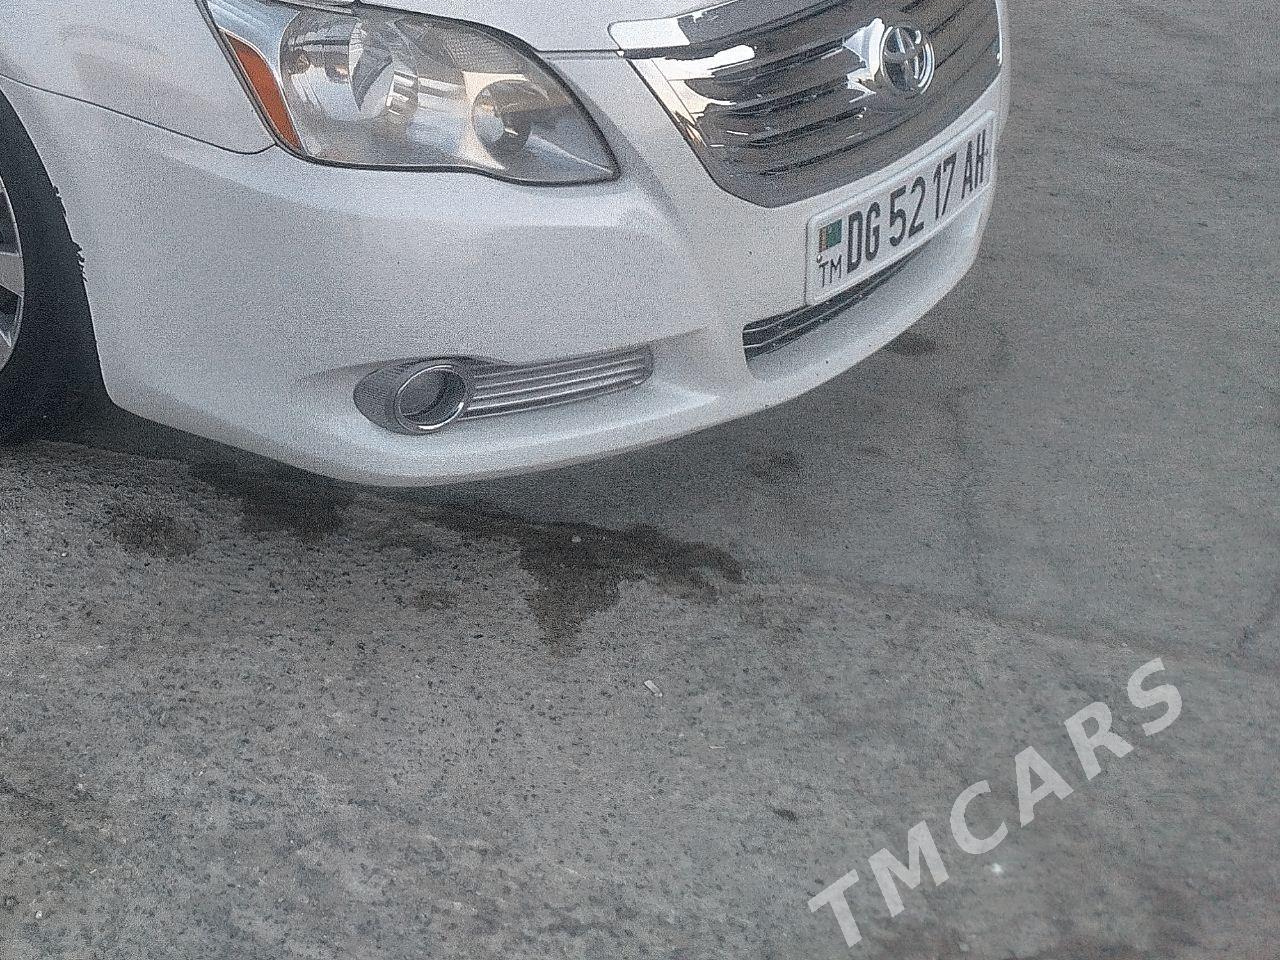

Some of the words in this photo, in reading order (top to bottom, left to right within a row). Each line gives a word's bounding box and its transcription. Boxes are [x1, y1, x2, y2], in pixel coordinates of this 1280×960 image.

[847, 202, 880, 275] DG
[888, 176, 926, 246] 52
[933, 152, 957, 221] 17
[961, 129, 987, 200] AH
[819, 255, 842, 287] TM
